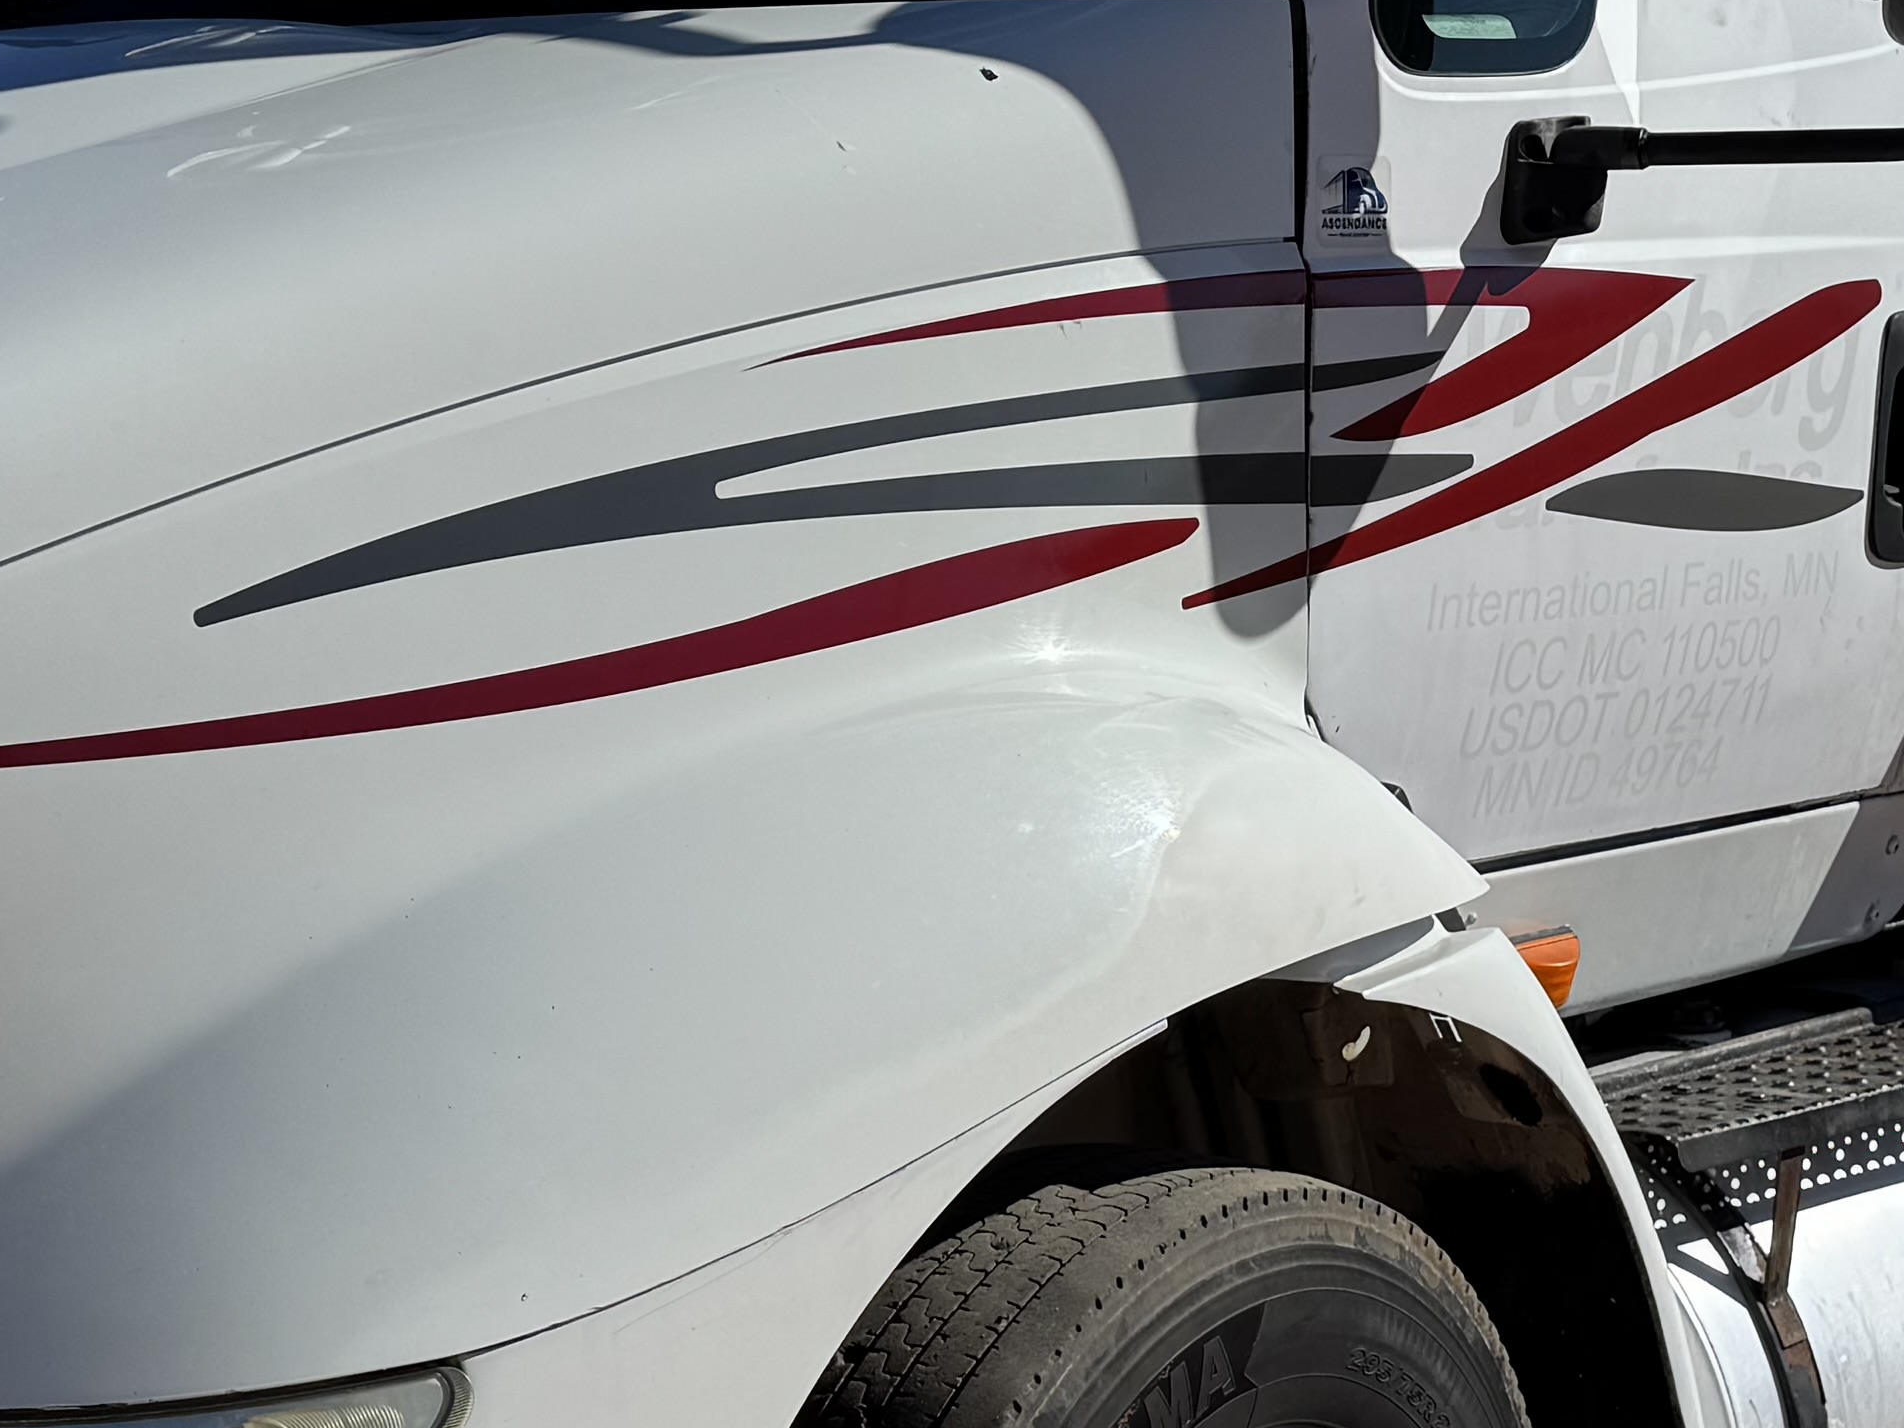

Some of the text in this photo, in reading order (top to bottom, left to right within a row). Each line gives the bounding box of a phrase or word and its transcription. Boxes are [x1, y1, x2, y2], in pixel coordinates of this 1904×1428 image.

[1321, 216, 1388, 230] ASCENDANCE
[1426, 551, 1840, 632] International Falls, MN
[1488, 615, 1781, 696] ICC MC 110500
[1459, 673, 1773, 759] USDOT 0124711
[1472, 736, 1725, 819] MN ID 49764
